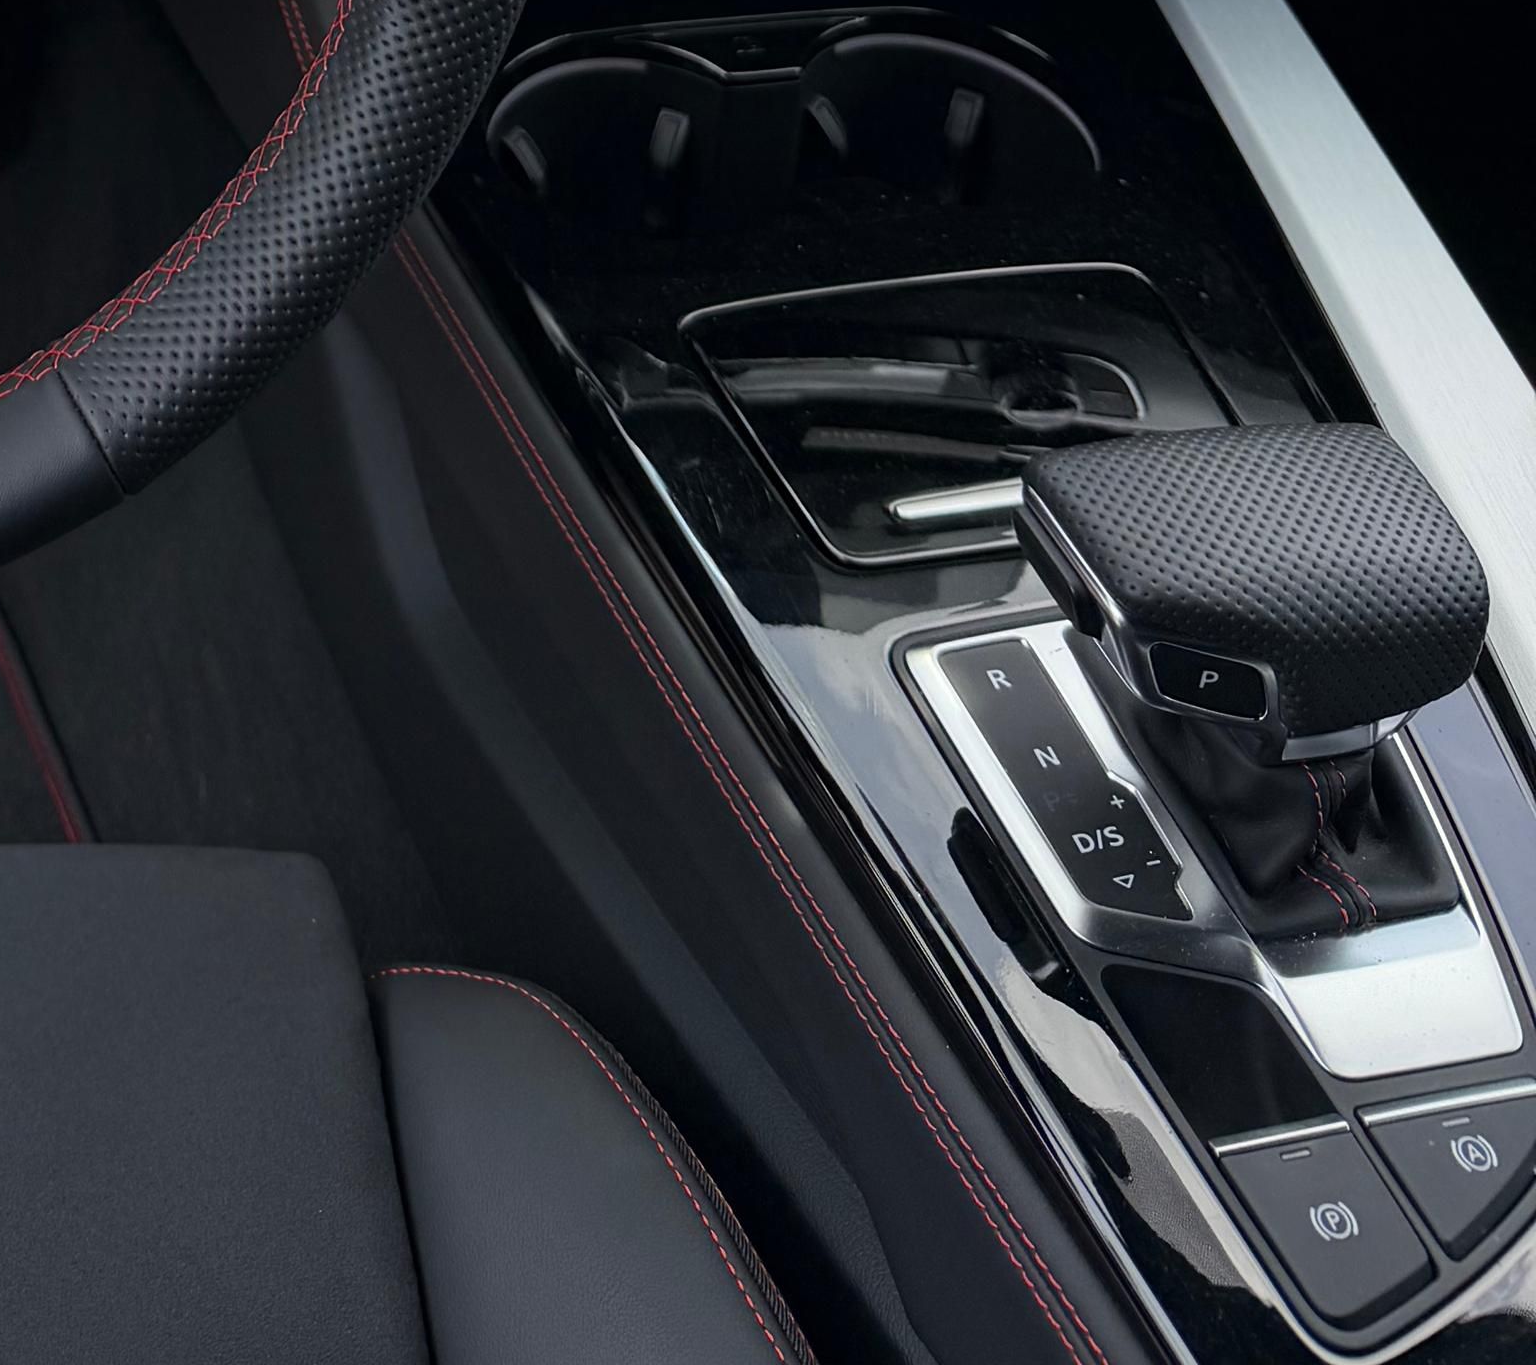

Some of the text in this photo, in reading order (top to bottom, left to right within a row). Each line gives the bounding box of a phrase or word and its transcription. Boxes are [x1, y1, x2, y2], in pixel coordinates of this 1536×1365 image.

[986, 669, 1012, 690] R
[1199, 670, 1219, 689] P
[1033, 745, 1061, 768] N
[1071, 825, 1124, 854] D/S
